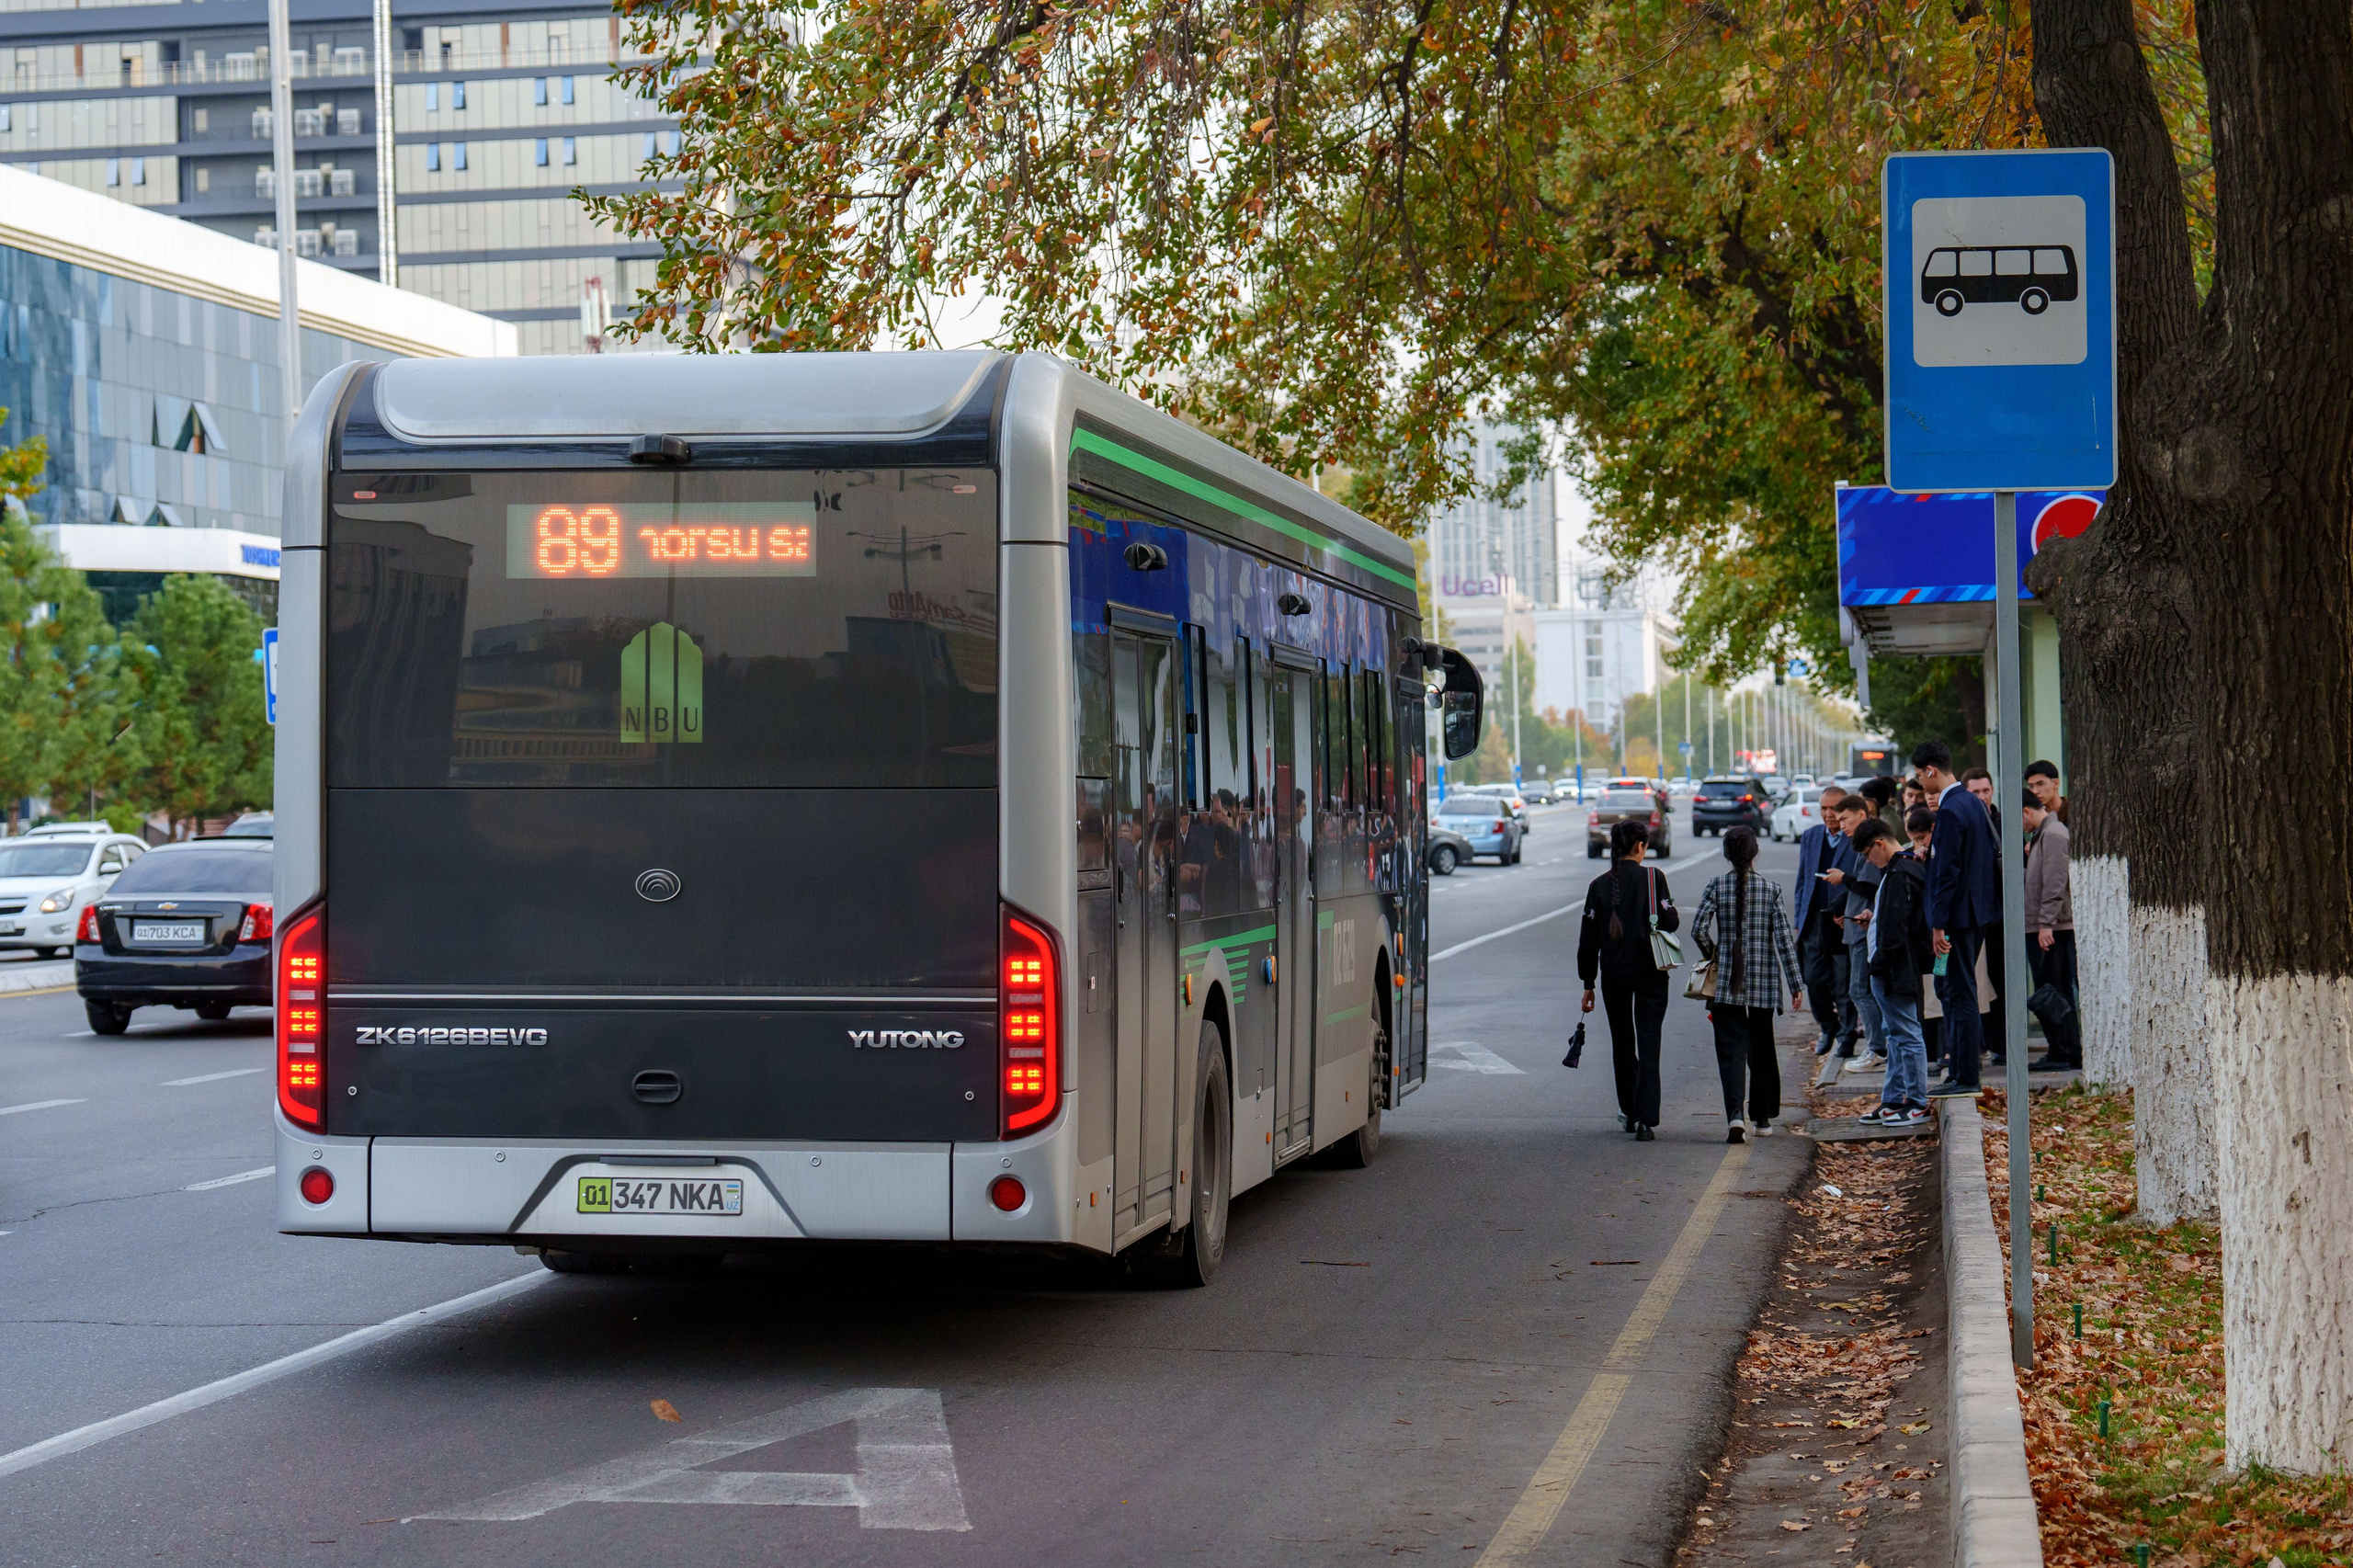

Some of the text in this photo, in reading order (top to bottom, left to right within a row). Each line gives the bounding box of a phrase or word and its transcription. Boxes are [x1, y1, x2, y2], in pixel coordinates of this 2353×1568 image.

[539, 508, 618, 573] 89
[1442, 573, 1508, 597] Ucell
[625, 707, 699, 733] NBU
[137, 927, 196, 938] 01 703 KCA
[356, 1027, 548, 1046] ZK6126BEVG
[847, 1030, 965, 1049] YUTONG
[585, 1182, 739, 1210] 01 347 NKA UZ
